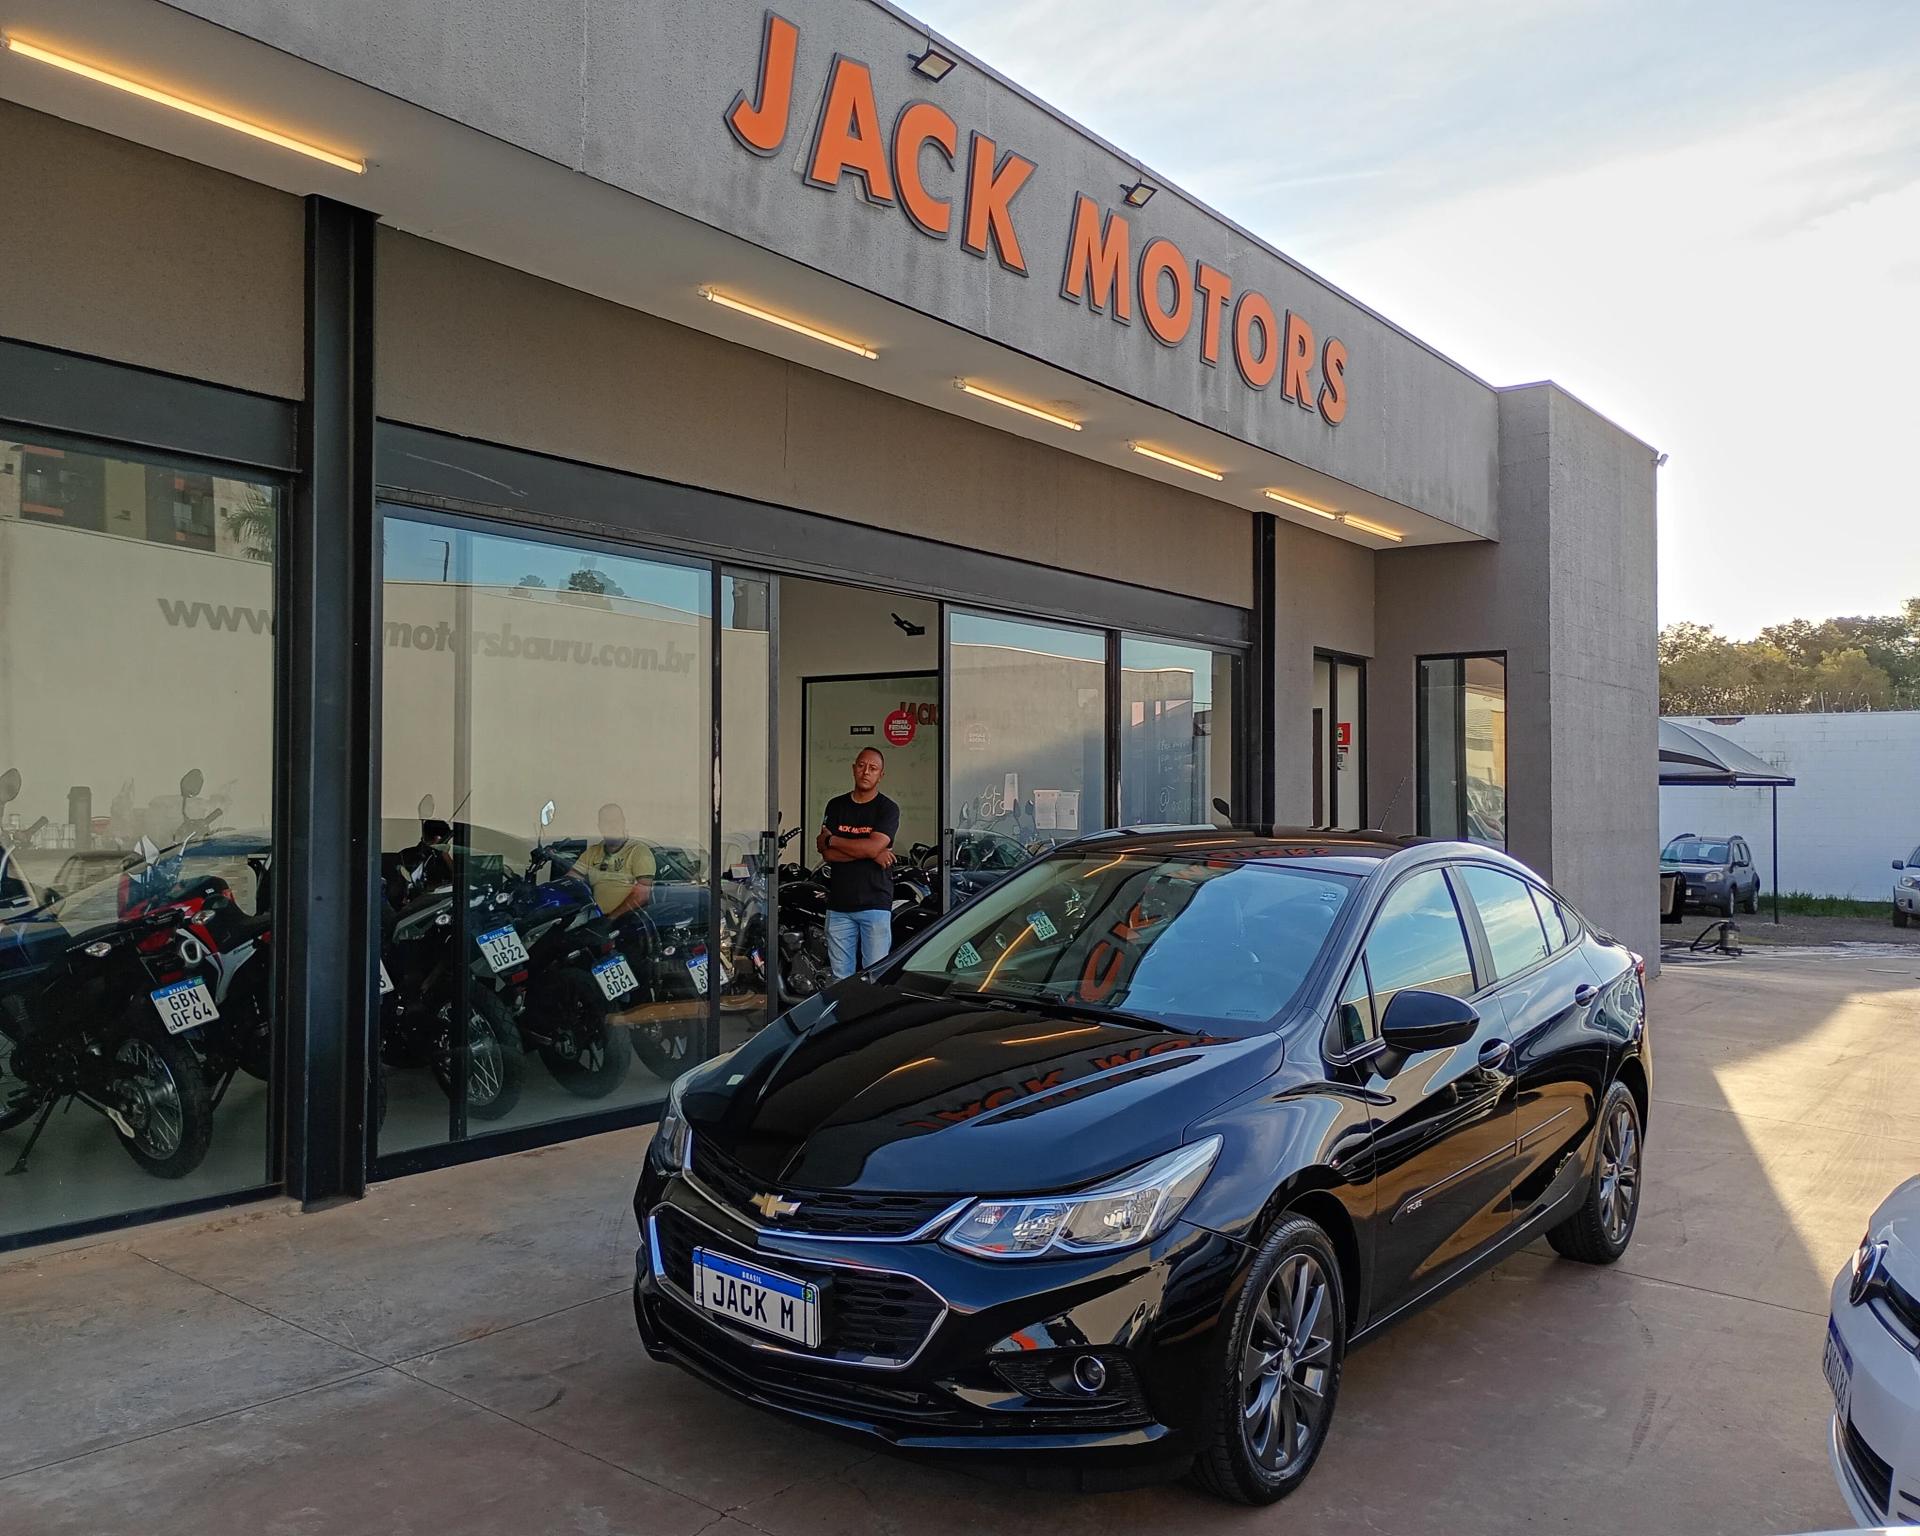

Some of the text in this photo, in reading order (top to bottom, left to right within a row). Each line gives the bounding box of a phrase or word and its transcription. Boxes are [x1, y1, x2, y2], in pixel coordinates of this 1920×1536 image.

[724, 8, 1349, 427] JACK MOTORS
[489, 935, 515, 953] TIZ
[492, 946, 525, 967] 0B22
[603, 964, 625, 983] FED
[606, 974, 634, 996] 8D61
[167, 988, 202, 1011] GBN
[741, 1271, 762, 1284] BRASIL
[712, 1274, 794, 1333] JACK M
